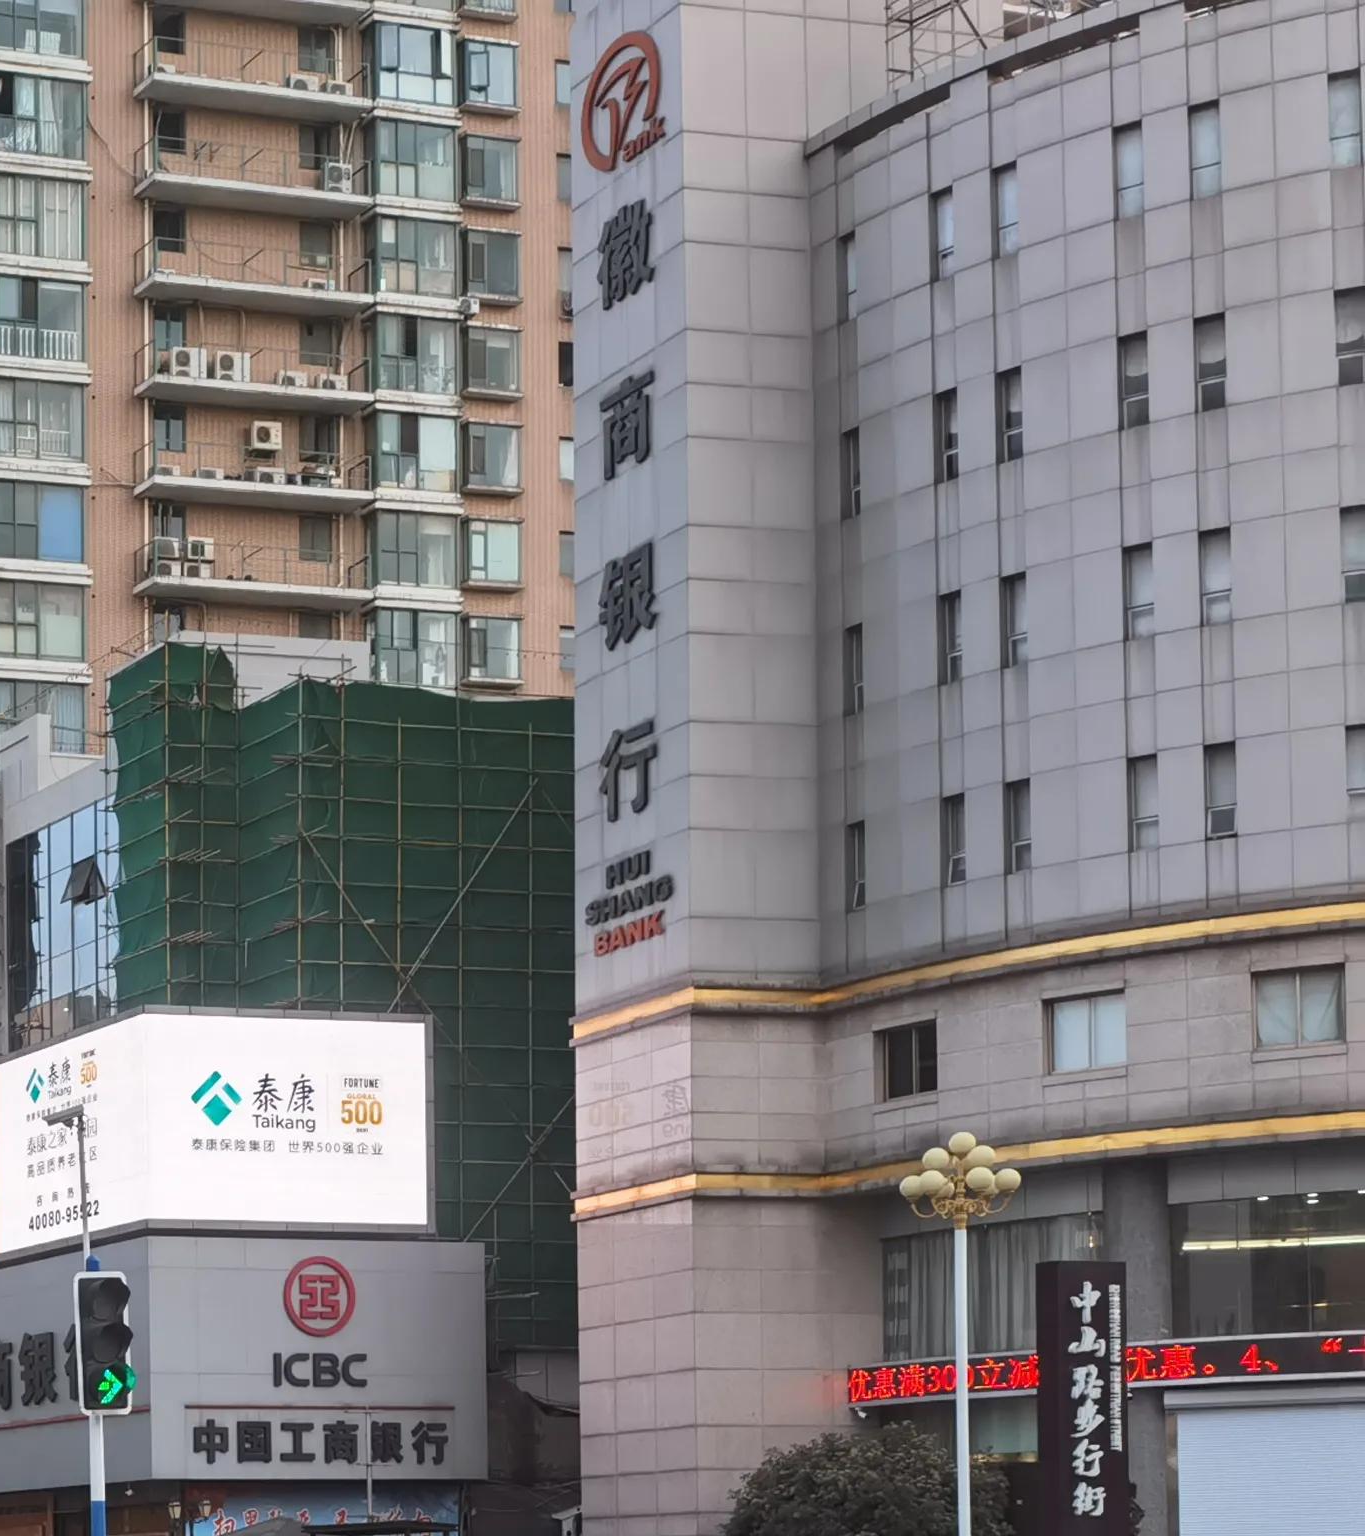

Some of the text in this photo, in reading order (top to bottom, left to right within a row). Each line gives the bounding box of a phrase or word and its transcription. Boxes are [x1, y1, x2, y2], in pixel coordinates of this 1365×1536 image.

[597, 199, 657, 823] 徽商银行
[605, 850, 652, 891] HUI
[584, 874, 675, 926] SHANG
[593, 910, 666, 957] BANK
[47, 1057, 72, 1088] 泰康
[344, 1078, 380, 1089] FORTUNE
[252, 1073, 315, 1113] 泰康
[252, 1115, 316, 1132] Taikang
[341, 1100, 383, 1125] 500
[26, 1145, 98, 1179] 高品质养老区
[192, 1138, 383, 1155] 泰康保险集团 世界500强企业
[272, 1352, 367, 1388] ICBC
[193, 1419, 449, 1465] 中国工商银行
